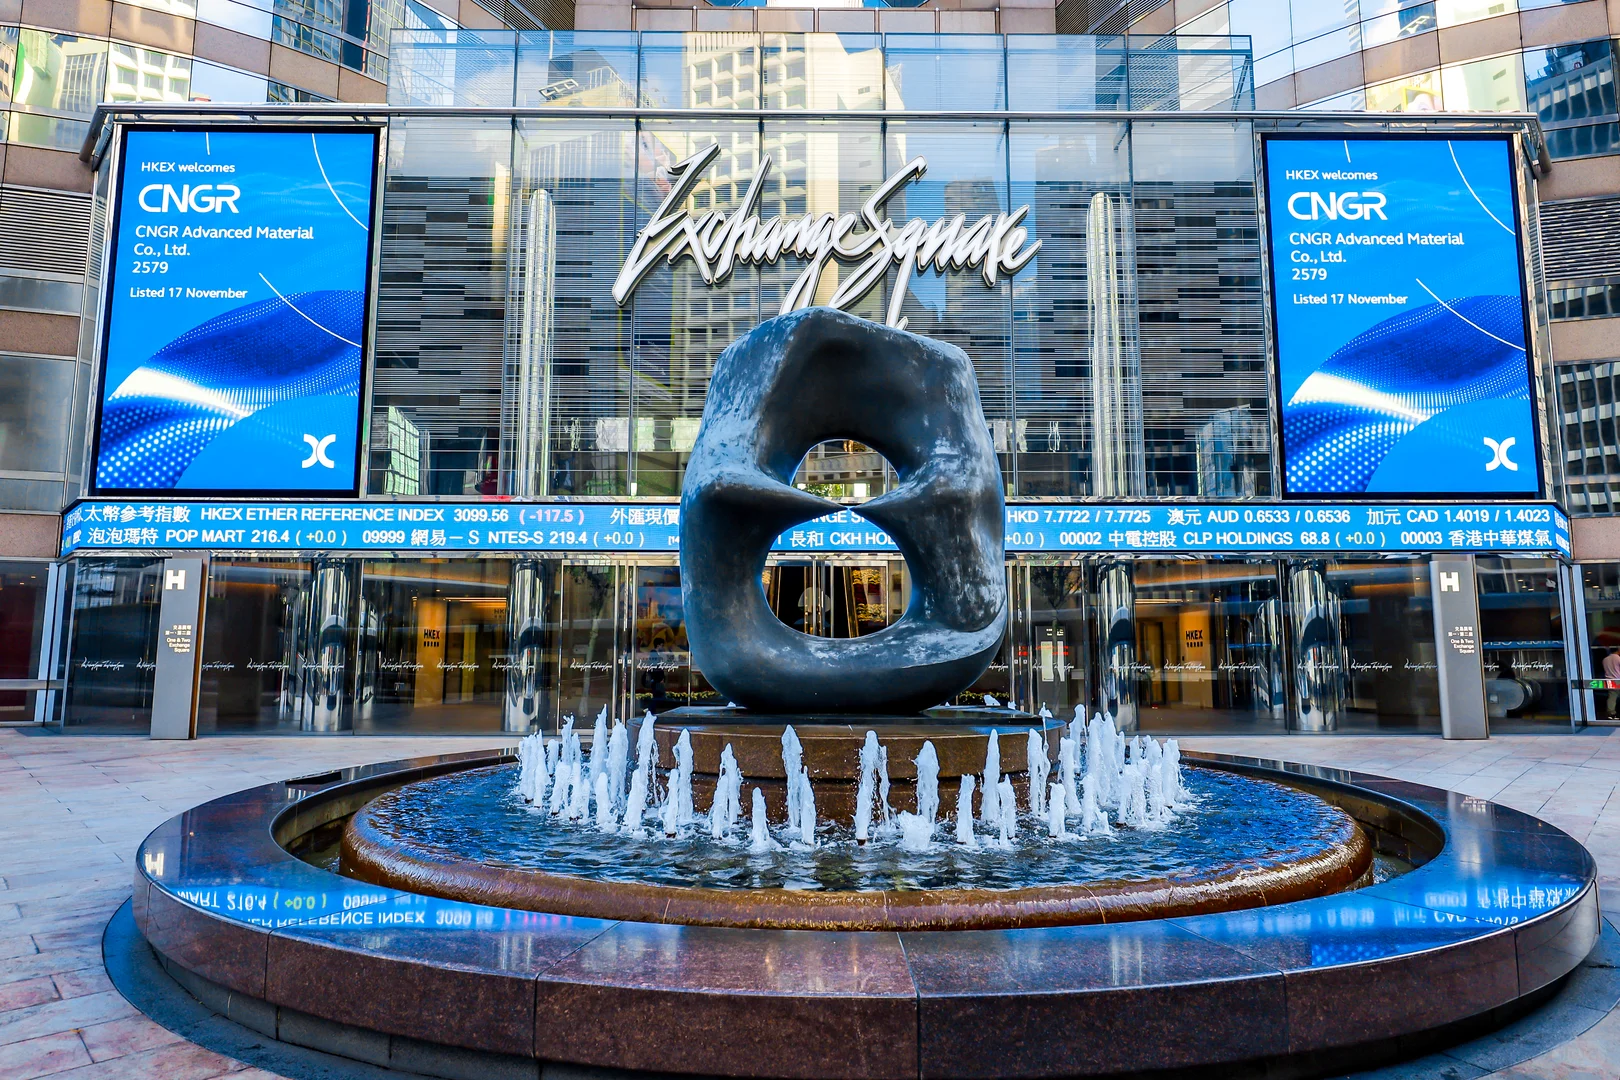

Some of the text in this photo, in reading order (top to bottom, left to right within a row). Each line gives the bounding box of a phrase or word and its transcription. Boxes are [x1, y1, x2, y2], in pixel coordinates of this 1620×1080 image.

[142, 162, 235, 172] HKEX welcomes
[1286, 170, 1378, 180] HKEX welcomes
[139, 184, 240, 213] CNGR
[1288, 192, 1387, 220] CNGR
[136, 226, 313, 239] CNGR Advanced Material
[612, 142, 1043, 332] Exchange Square
[1290, 233, 1464, 245] CNGR Advanced Material
[134, 244, 190, 257] Co., Ltd.
[1291, 250, 1346, 264] Co., Ltd.
[133, 262, 168, 273] 2579
[1293, 268, 1327, 280] 2579
[130, 287, 247, 298] Listed 17 November
[1294, 294, 1408, 304] Listed 17 November
[201, 508, 242, 520] HKEX
[246, 508, 297, 520] ETHER
[302, 508, 394, 521] REFERENCE
[398, 509, 444, 521] INDEX
[454, 509, 509, 522] 3099.56
[1008, 510, 1039, 523] HKD
[1044, 510, 1090, 523] 7.7722
[1105, 510, 1151, 523] 7.7725
[1168, 508, 1201, 525] 澳元
[1207, 510, 1239, 522] AUD
[1244, 510, 1290, 523] 0.6533
[1305, 510, 1350, 522] 0.6536
[1367, 509, 1401, 525] 加元
[1407, 510, 1438, 522] CAD
[1445, 510, 1489, 522] 1.4019
[1505, 510, 1550, 522] 1.4023
[88, 528, 158, 544] 泡泡瑪特
[166, 530, 198, 542] POP
[202, 530, 245, 542] MART
[251, 530, 289, 542] 216.4
[363, 530, 405, 543] 09999
[488, 531, 543, 544] NTES-S
[549, 531, 588, 544] 219.4
[790, 531, 823, 547] 長和
[830, 532, 861, 545] CKH
[1060, 532, 1101, 545] 00002
[1109, 530, 1176, 547] 中電控股
[1184, 532, 1212, 544] CLP
[1216, 532, 1293, 544] HOLDINGS
[1301, 532, 1330, 544] 68.8
[1401, 532, 1442, 544] 00003
[1449, 529, 1552, 546] 香港中華煤氣
